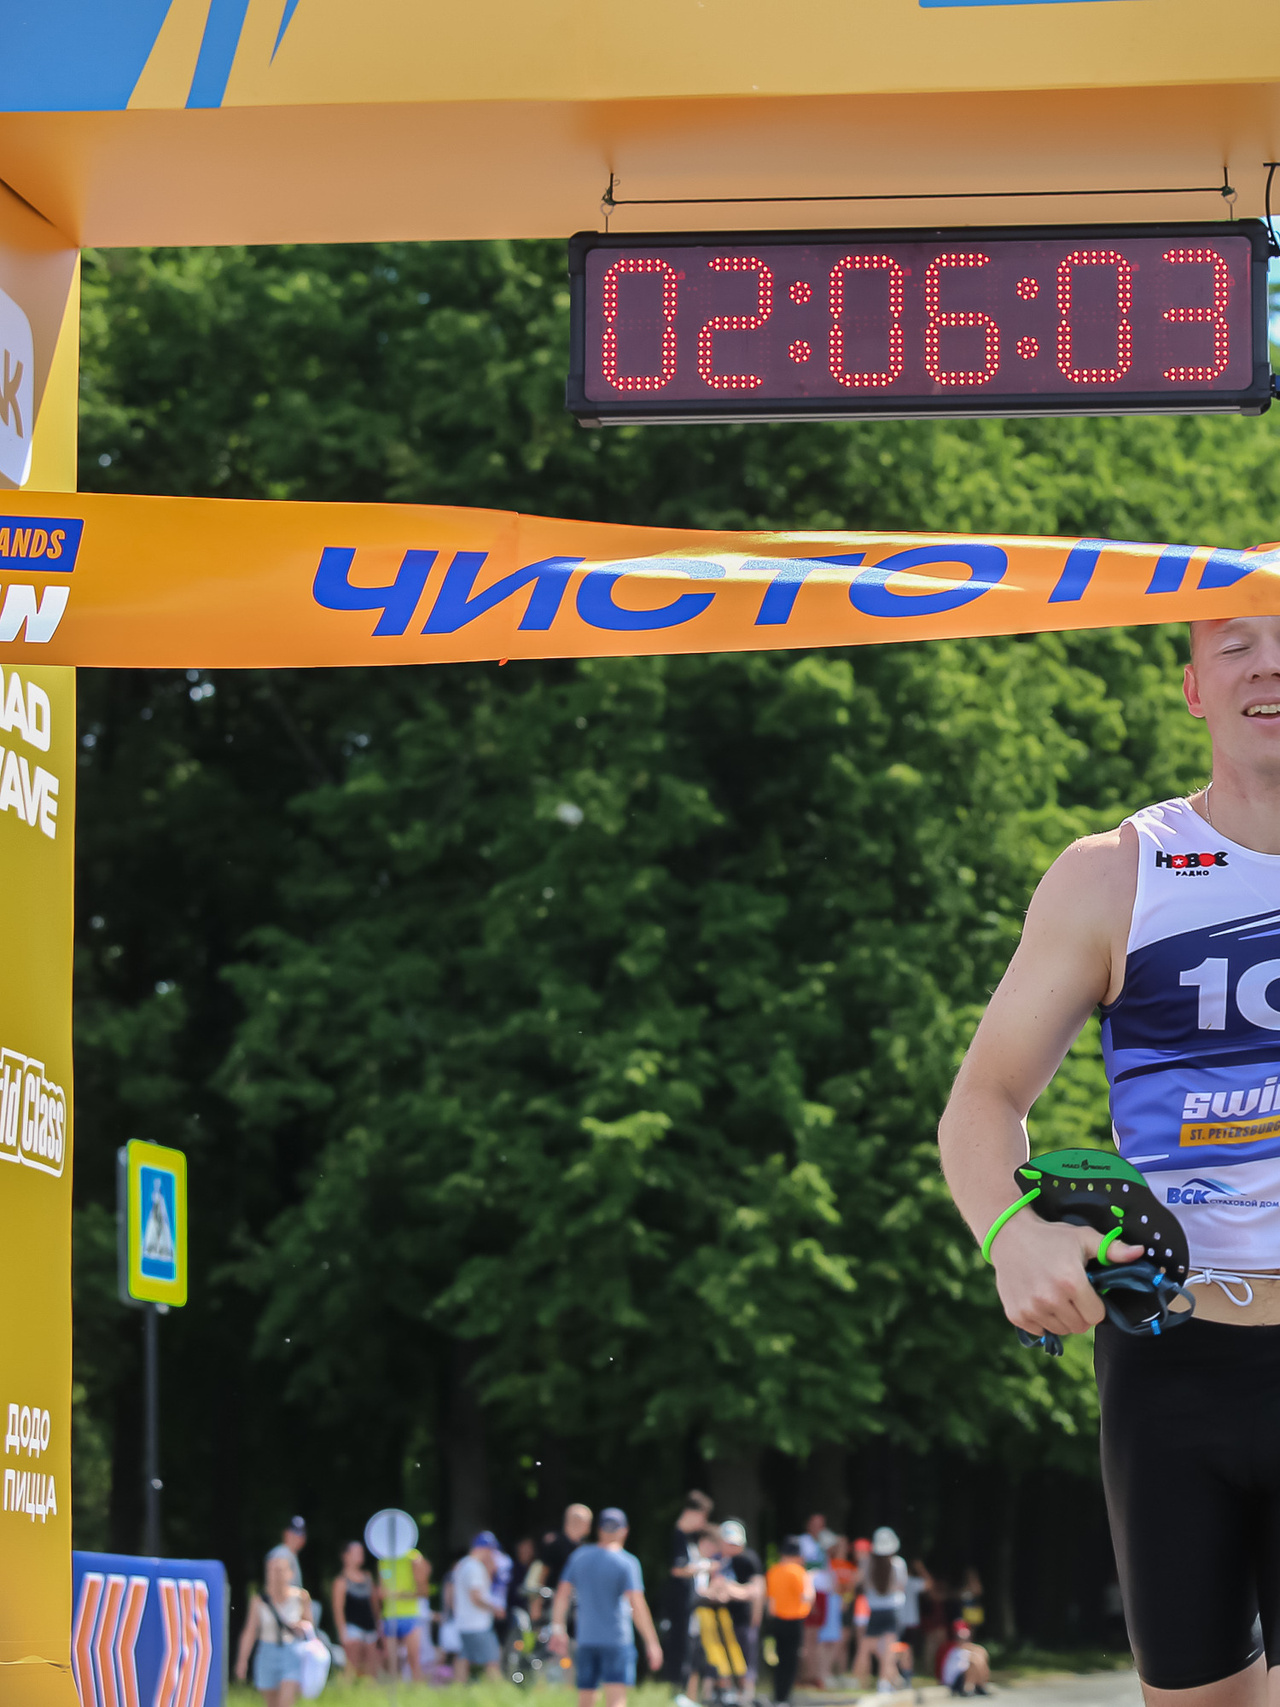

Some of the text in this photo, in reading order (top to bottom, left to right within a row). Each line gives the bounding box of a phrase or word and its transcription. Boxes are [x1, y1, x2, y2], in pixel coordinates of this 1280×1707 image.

[602, 249, 1229, 390] 02:06:03
[313, 543, 1009, 637] ЧИСТО
[0, 664, 51, 752] AD
[0, 746, 60, 839] AVE
[22, 1072, 64, 1163] Class
[1189, 1128, 1206, 1141] ST.
[1166, 1187, 1280, 1208] ВСК СТРАХОВОЙ ДОМ
[5, 1402, 51, 1458] ДОДО
[3, 1468, 58, 1524] ПИЦЦА
